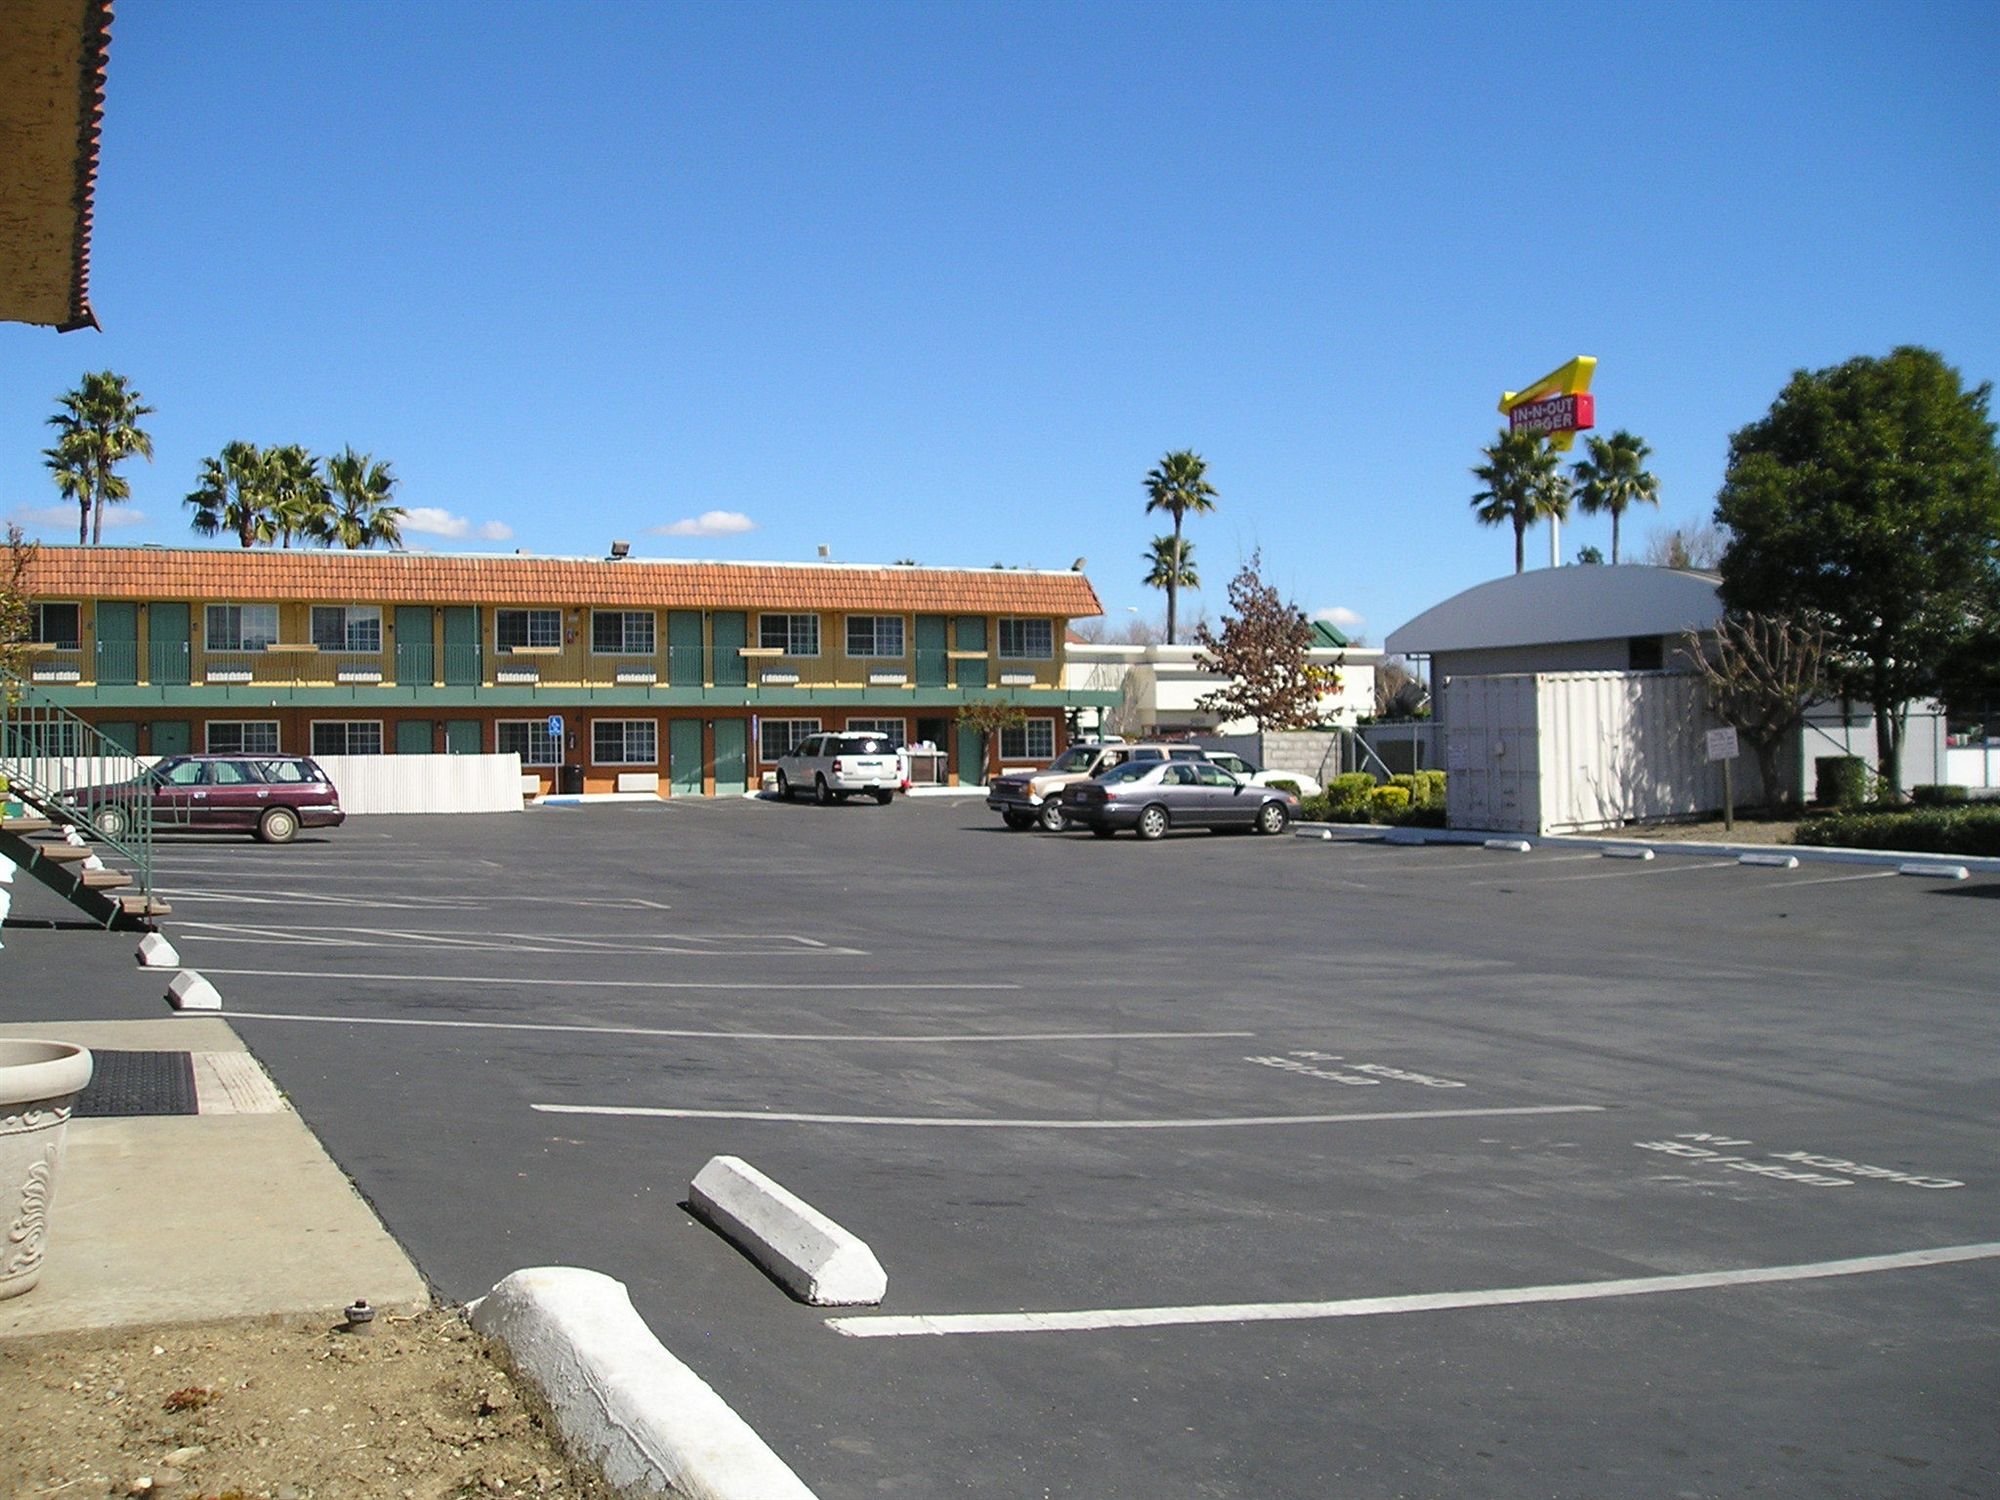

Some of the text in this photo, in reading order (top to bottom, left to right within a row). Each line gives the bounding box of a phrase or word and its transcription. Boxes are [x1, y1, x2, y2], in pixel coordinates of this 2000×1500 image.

[1513, 398, 1574, 423] IN-N-OUT
[1633, 1139, 1855, 1187] OFFICE
[1674, 1132, 1966, 1189] CHECK IN
